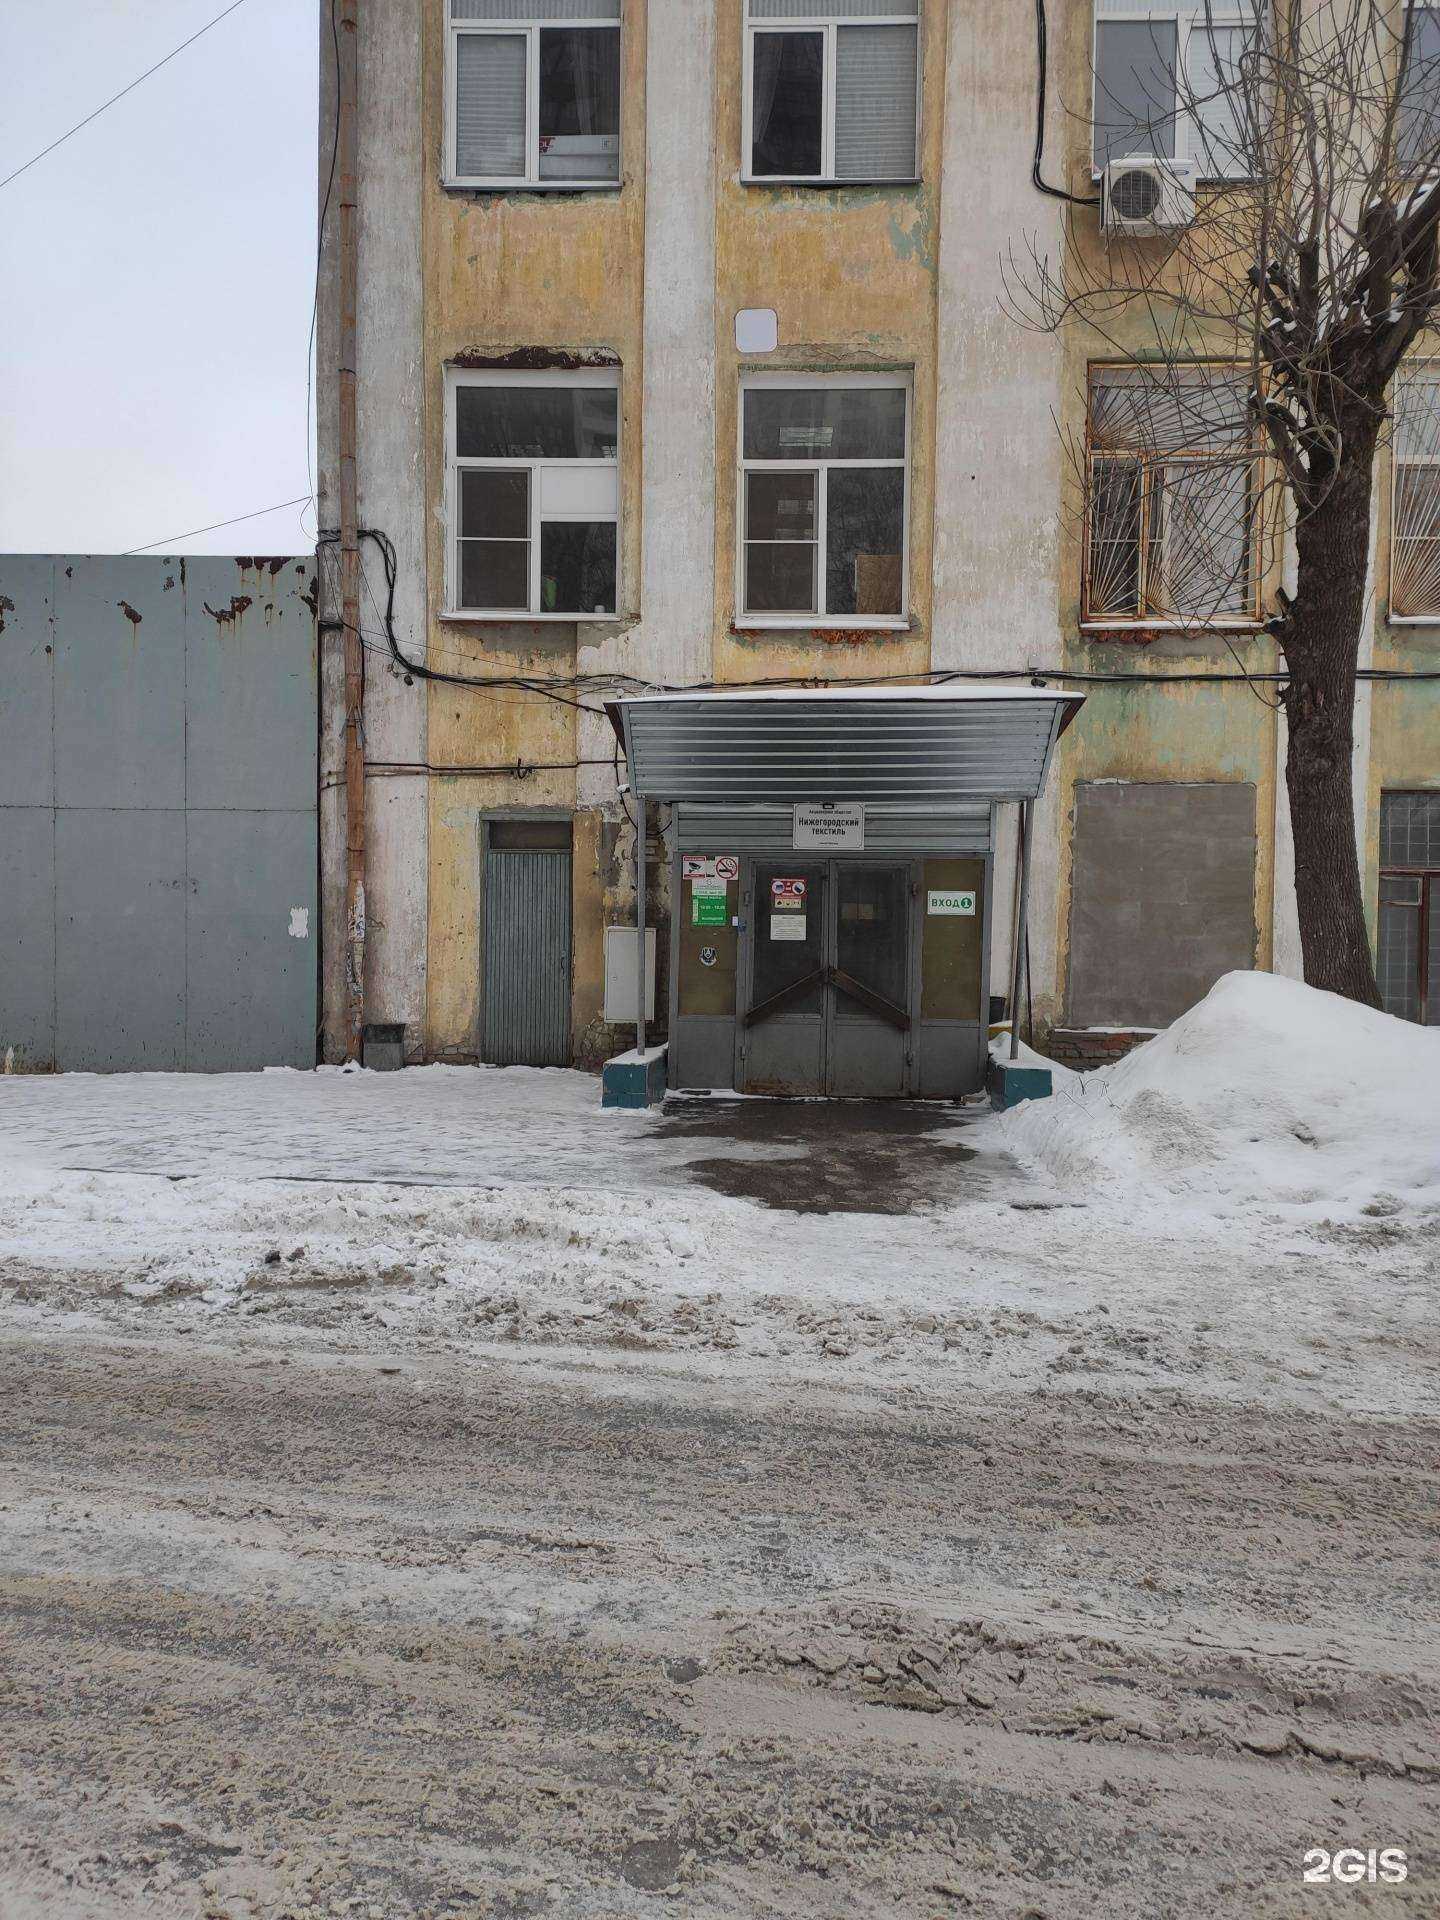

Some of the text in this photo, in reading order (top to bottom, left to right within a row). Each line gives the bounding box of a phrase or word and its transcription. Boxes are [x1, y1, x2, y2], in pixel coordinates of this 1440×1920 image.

[798, 817, 859, 827] Нижегородский
[812, 828, 846, 836] текстиль
[931, 899, 960, 908] ВХОД
